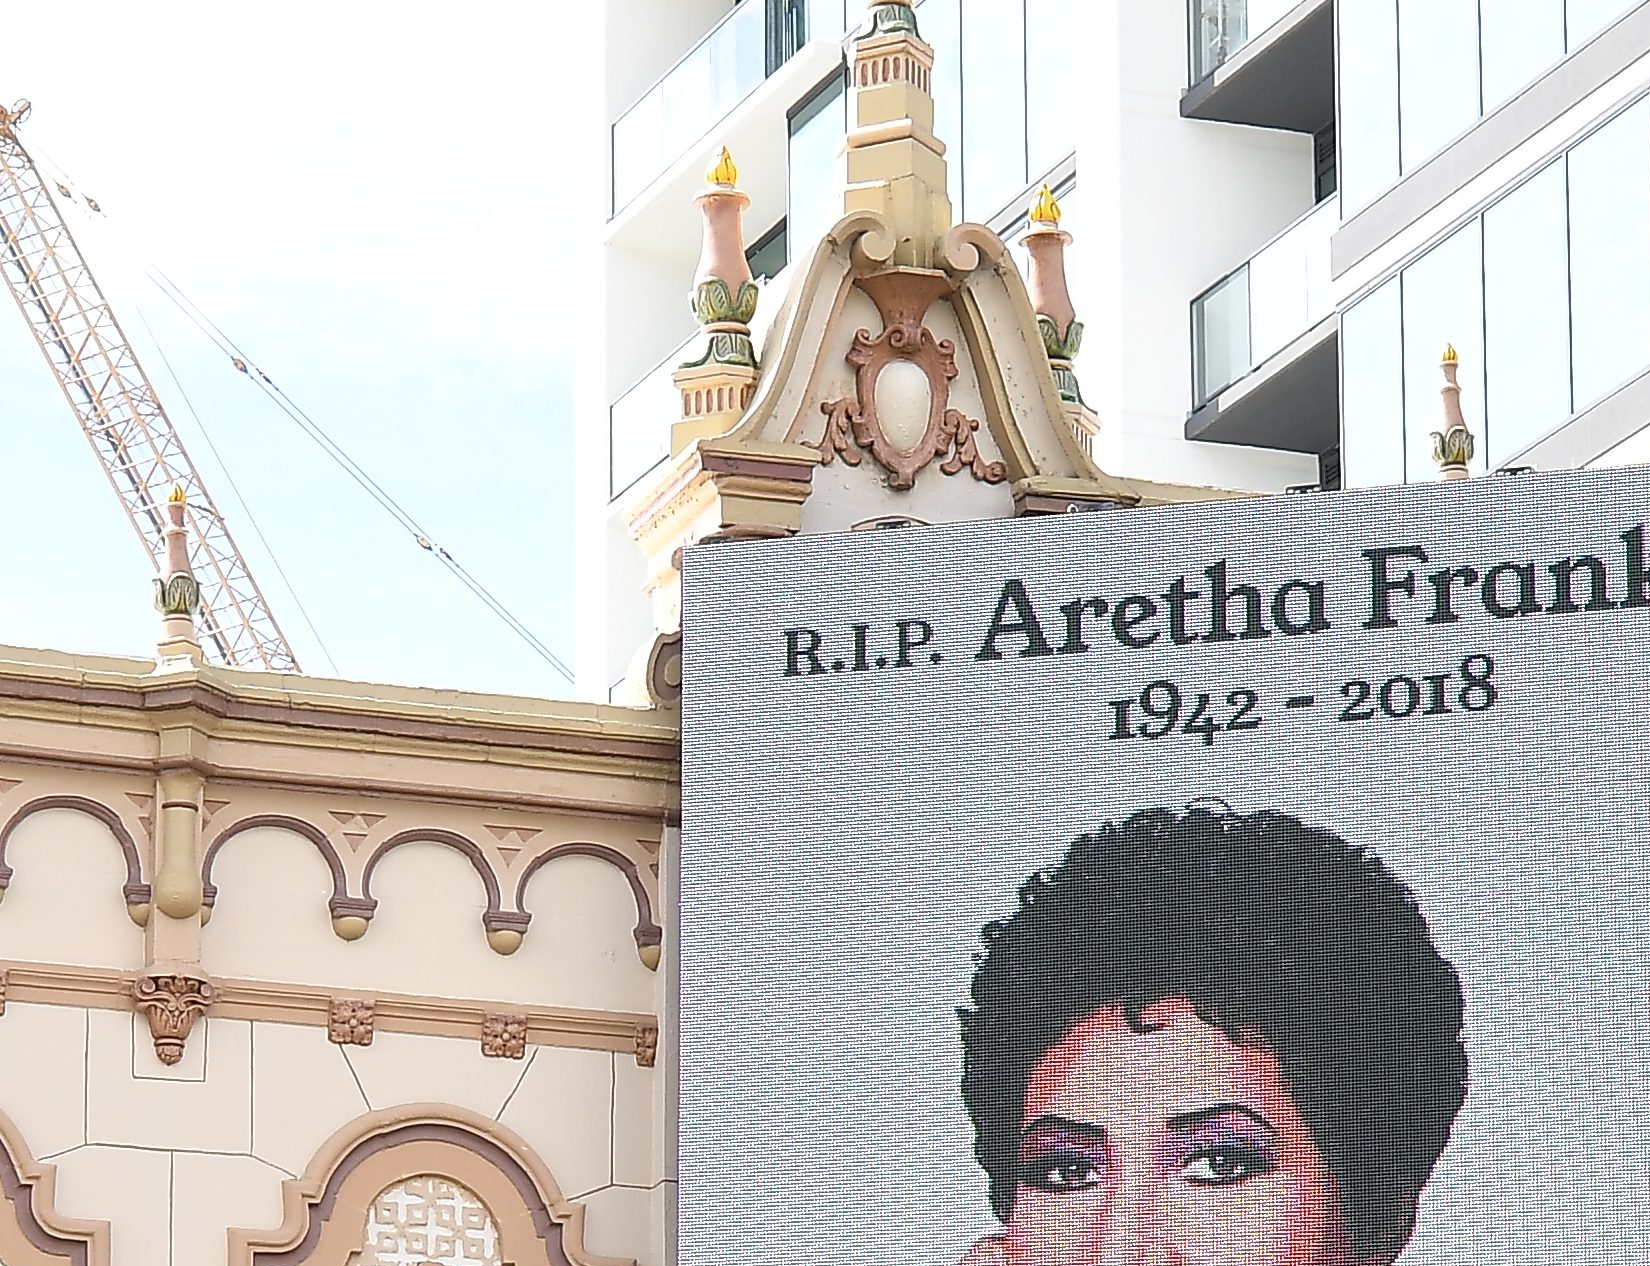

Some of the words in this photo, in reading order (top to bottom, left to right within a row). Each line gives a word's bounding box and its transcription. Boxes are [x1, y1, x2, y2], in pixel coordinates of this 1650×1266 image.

[783, 619, 942, 678] R.I.P.
[974, 558, 1332, 661] Aretha
[1108, 680, 1263, 746] 1942
[1338, 653, 1498, 722] 2018
